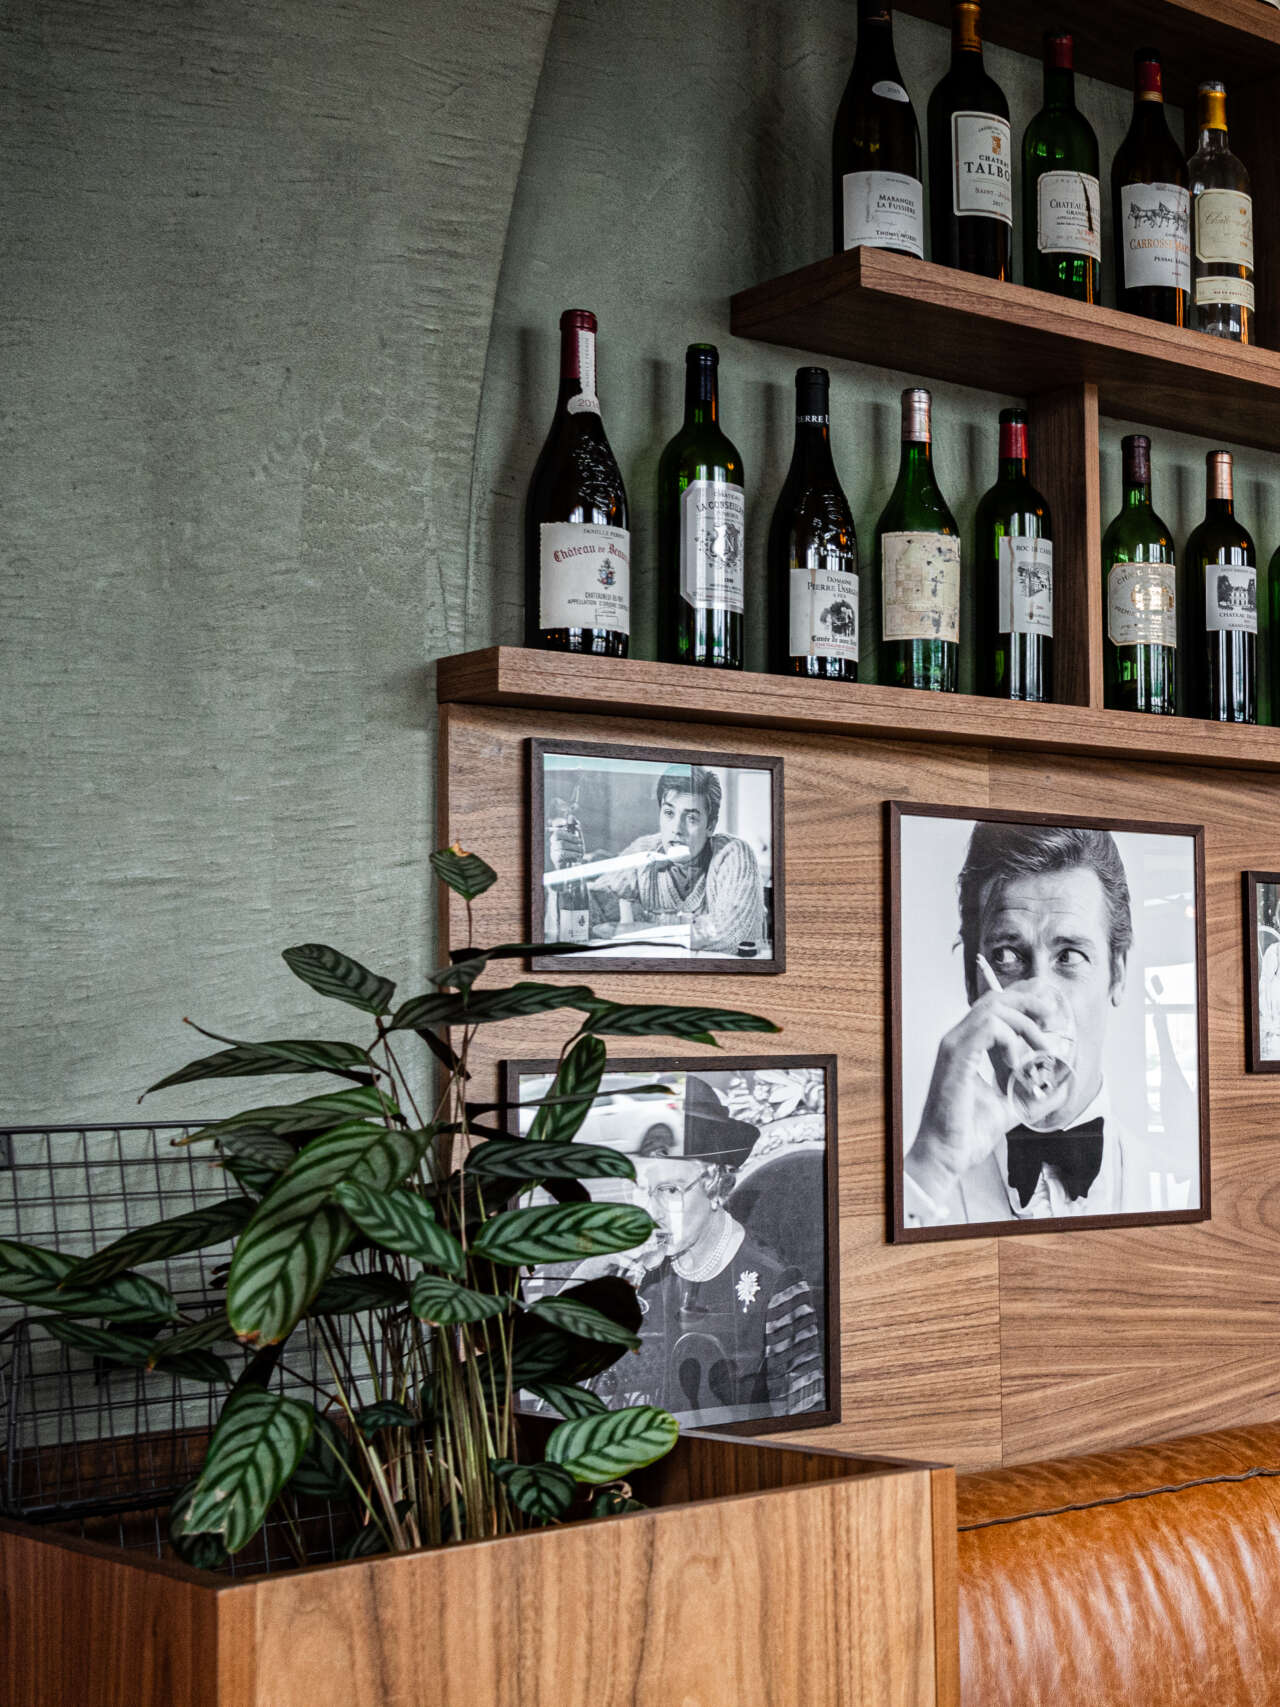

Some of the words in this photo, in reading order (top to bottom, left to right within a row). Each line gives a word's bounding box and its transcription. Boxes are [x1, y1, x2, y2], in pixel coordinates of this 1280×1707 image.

[964, 161, 1010, 182] TALBO
[553, 545, 596, 562] Château
[808, 582, 836, 591] PIERRE
